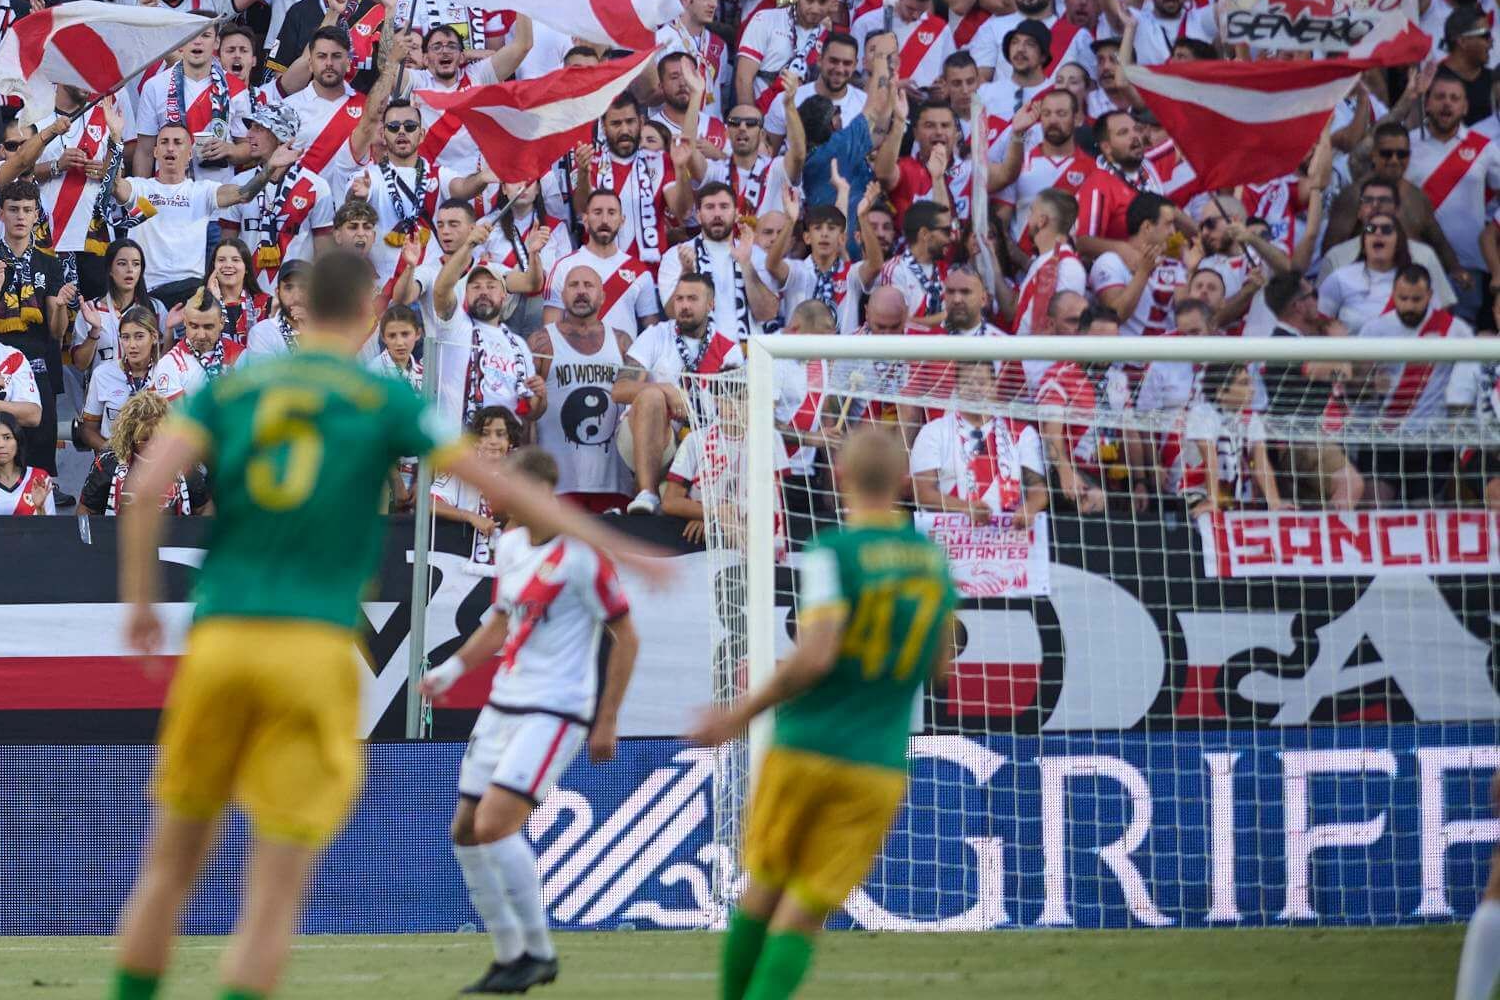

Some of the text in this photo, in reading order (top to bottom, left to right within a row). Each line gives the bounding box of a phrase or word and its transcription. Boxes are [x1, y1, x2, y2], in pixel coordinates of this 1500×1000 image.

[1227, 5, 1375, 46] GÉNERO
[556, 364, 616, 387] NO WORRIE
[246, 385, 325, 510] 5
[1231, 511, 1500, 567] SANCIO
[842, 576, 943, 681] 47
